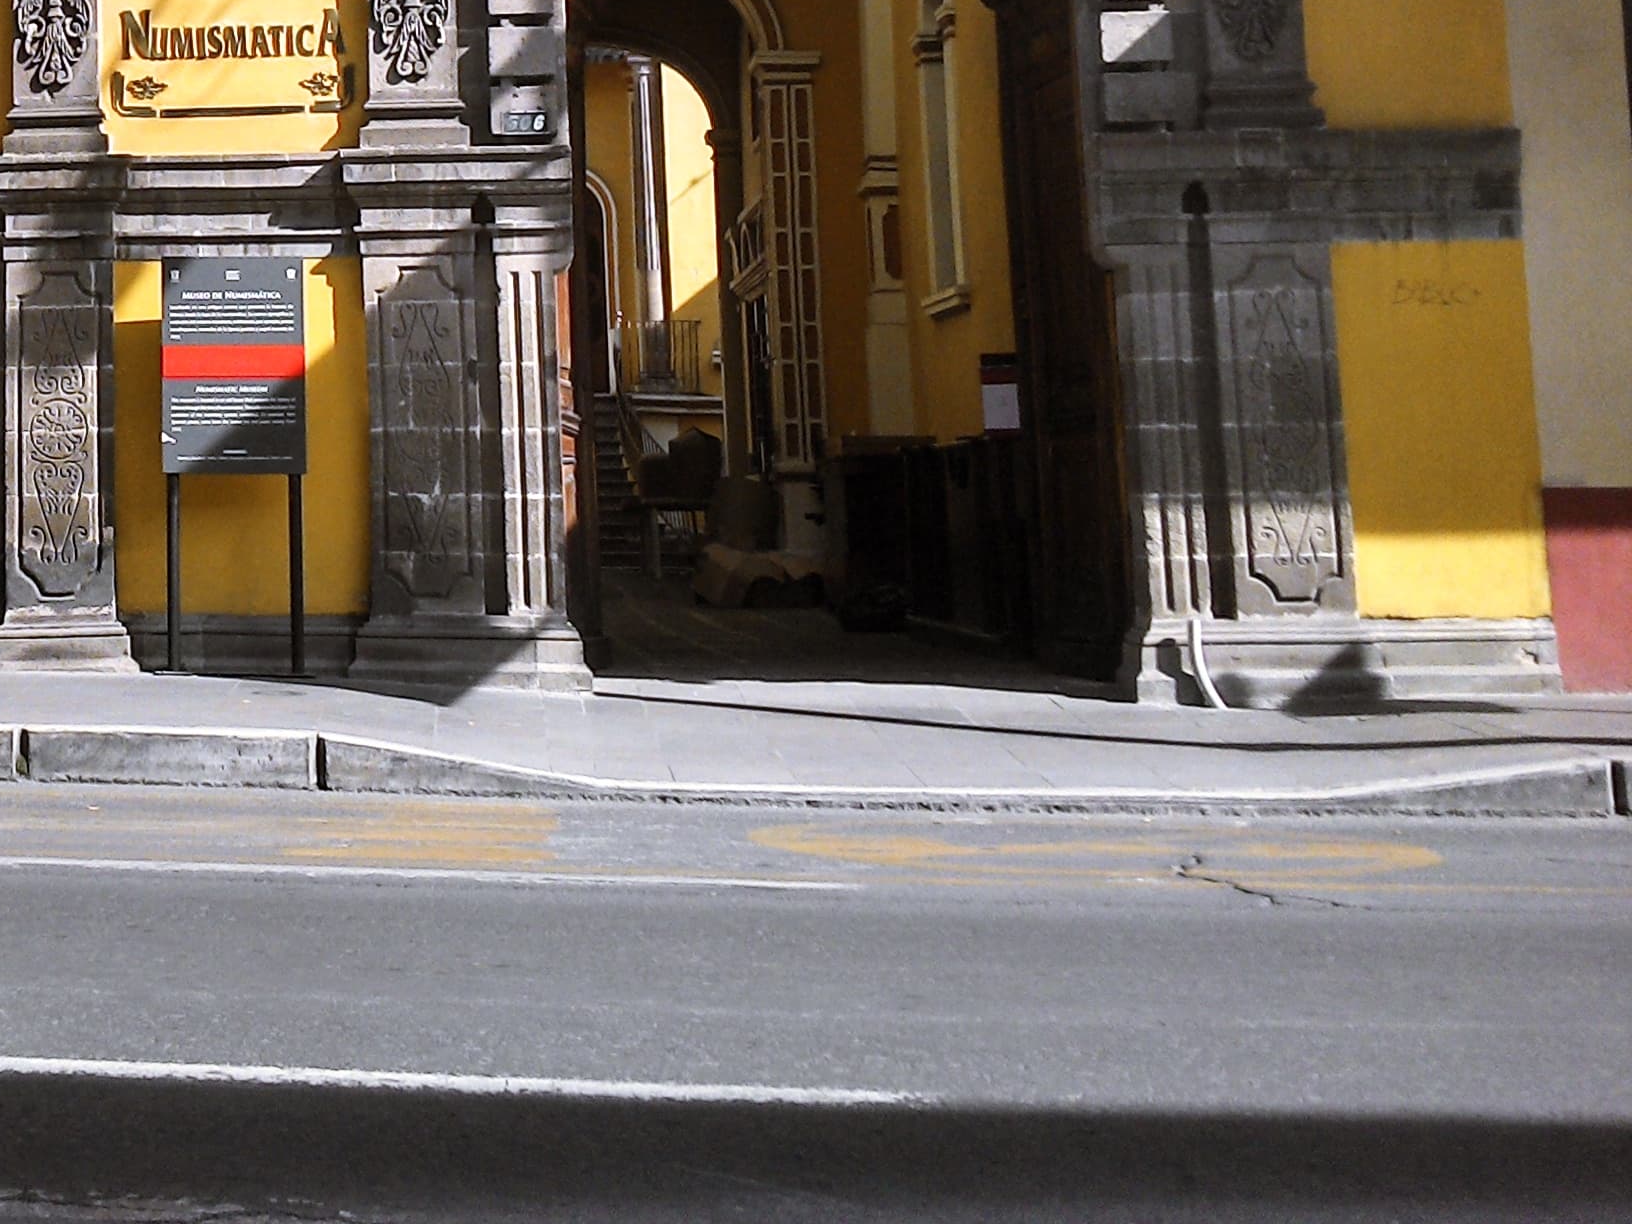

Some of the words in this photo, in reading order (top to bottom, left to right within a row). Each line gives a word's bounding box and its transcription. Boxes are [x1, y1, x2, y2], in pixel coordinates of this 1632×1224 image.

[119, 8, 345, 61] NUMISMATICA
[181, 290, 211, 300] MUSEO
[211, 290, 223, 300] DE
